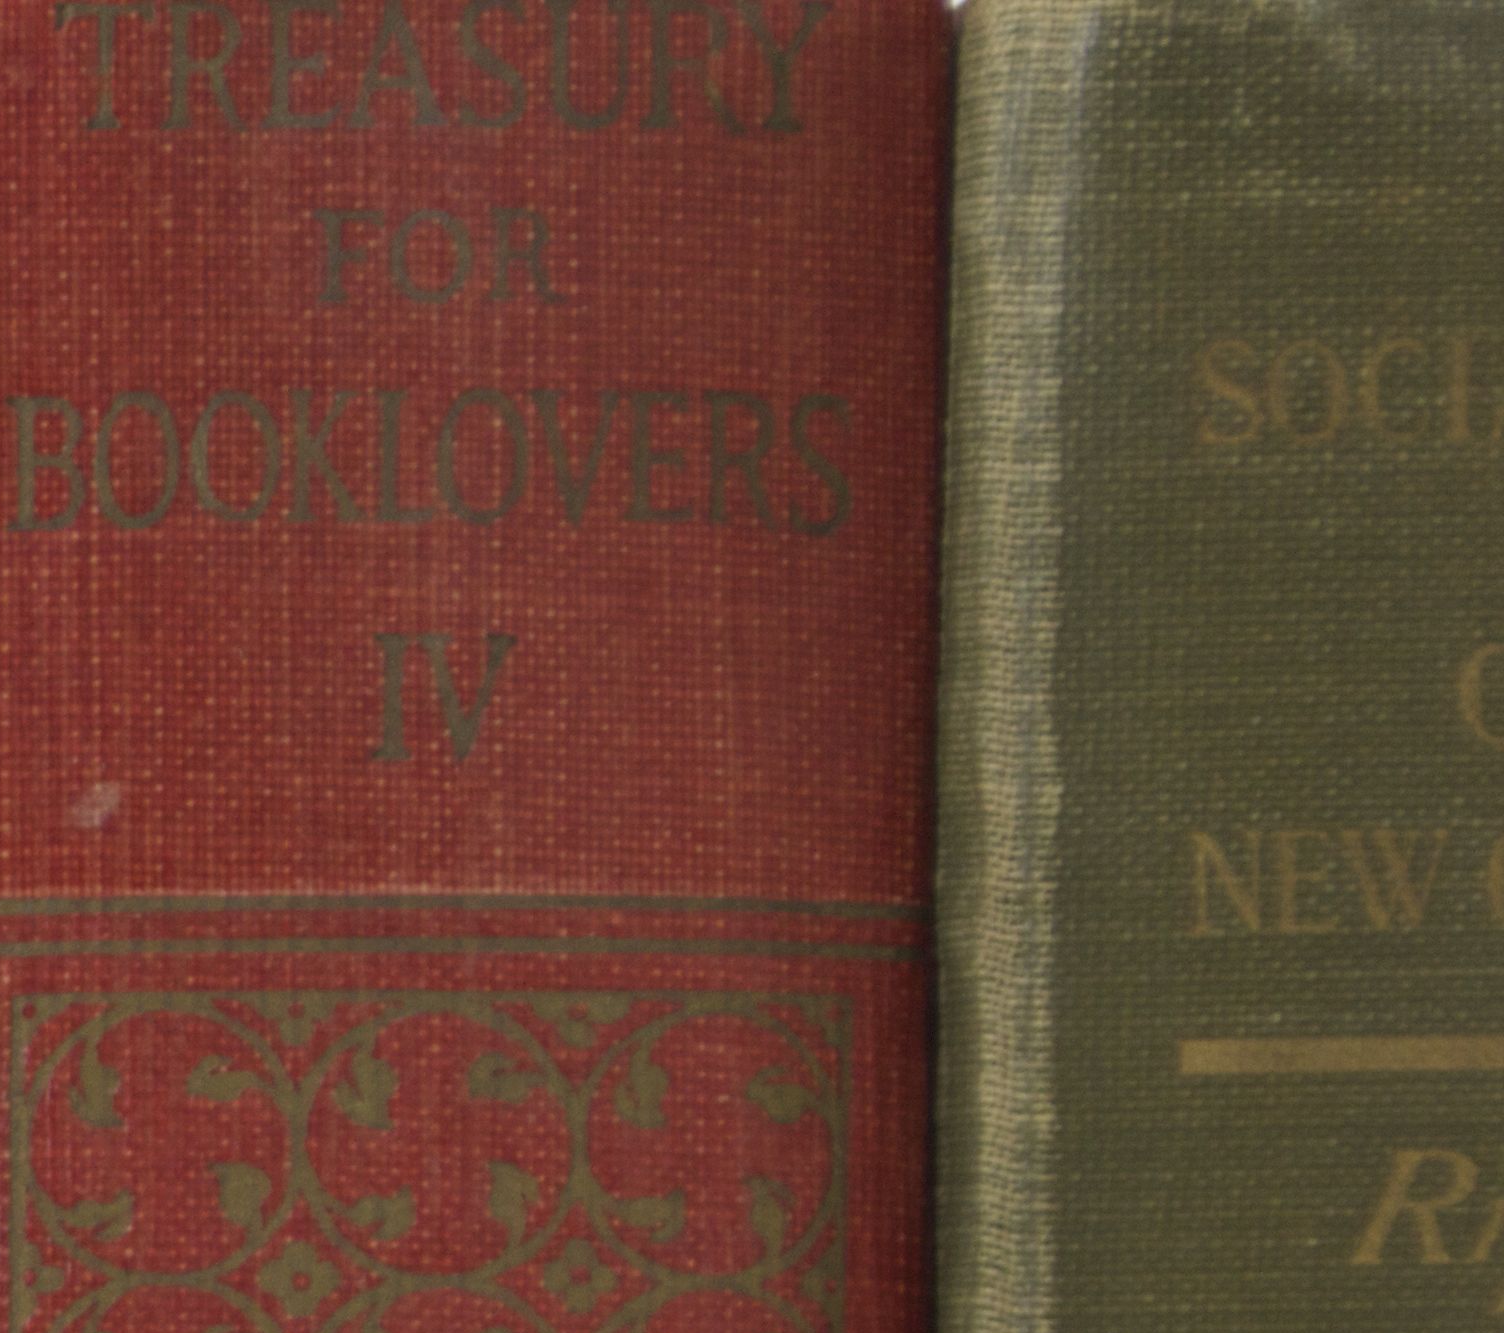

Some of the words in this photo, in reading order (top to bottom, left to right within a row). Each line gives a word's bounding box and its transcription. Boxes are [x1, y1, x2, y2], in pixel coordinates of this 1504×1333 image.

[54, 0, 835, 135] TREASURY
[313, 207, 568, 306] FOR
[1196, 336, 1504, 444] SOCI
[5, 388, 856, 537] BOOKLOVERS
[368, 632, 518, 764] IV
[1188, 830, 1449, 937] NEW
